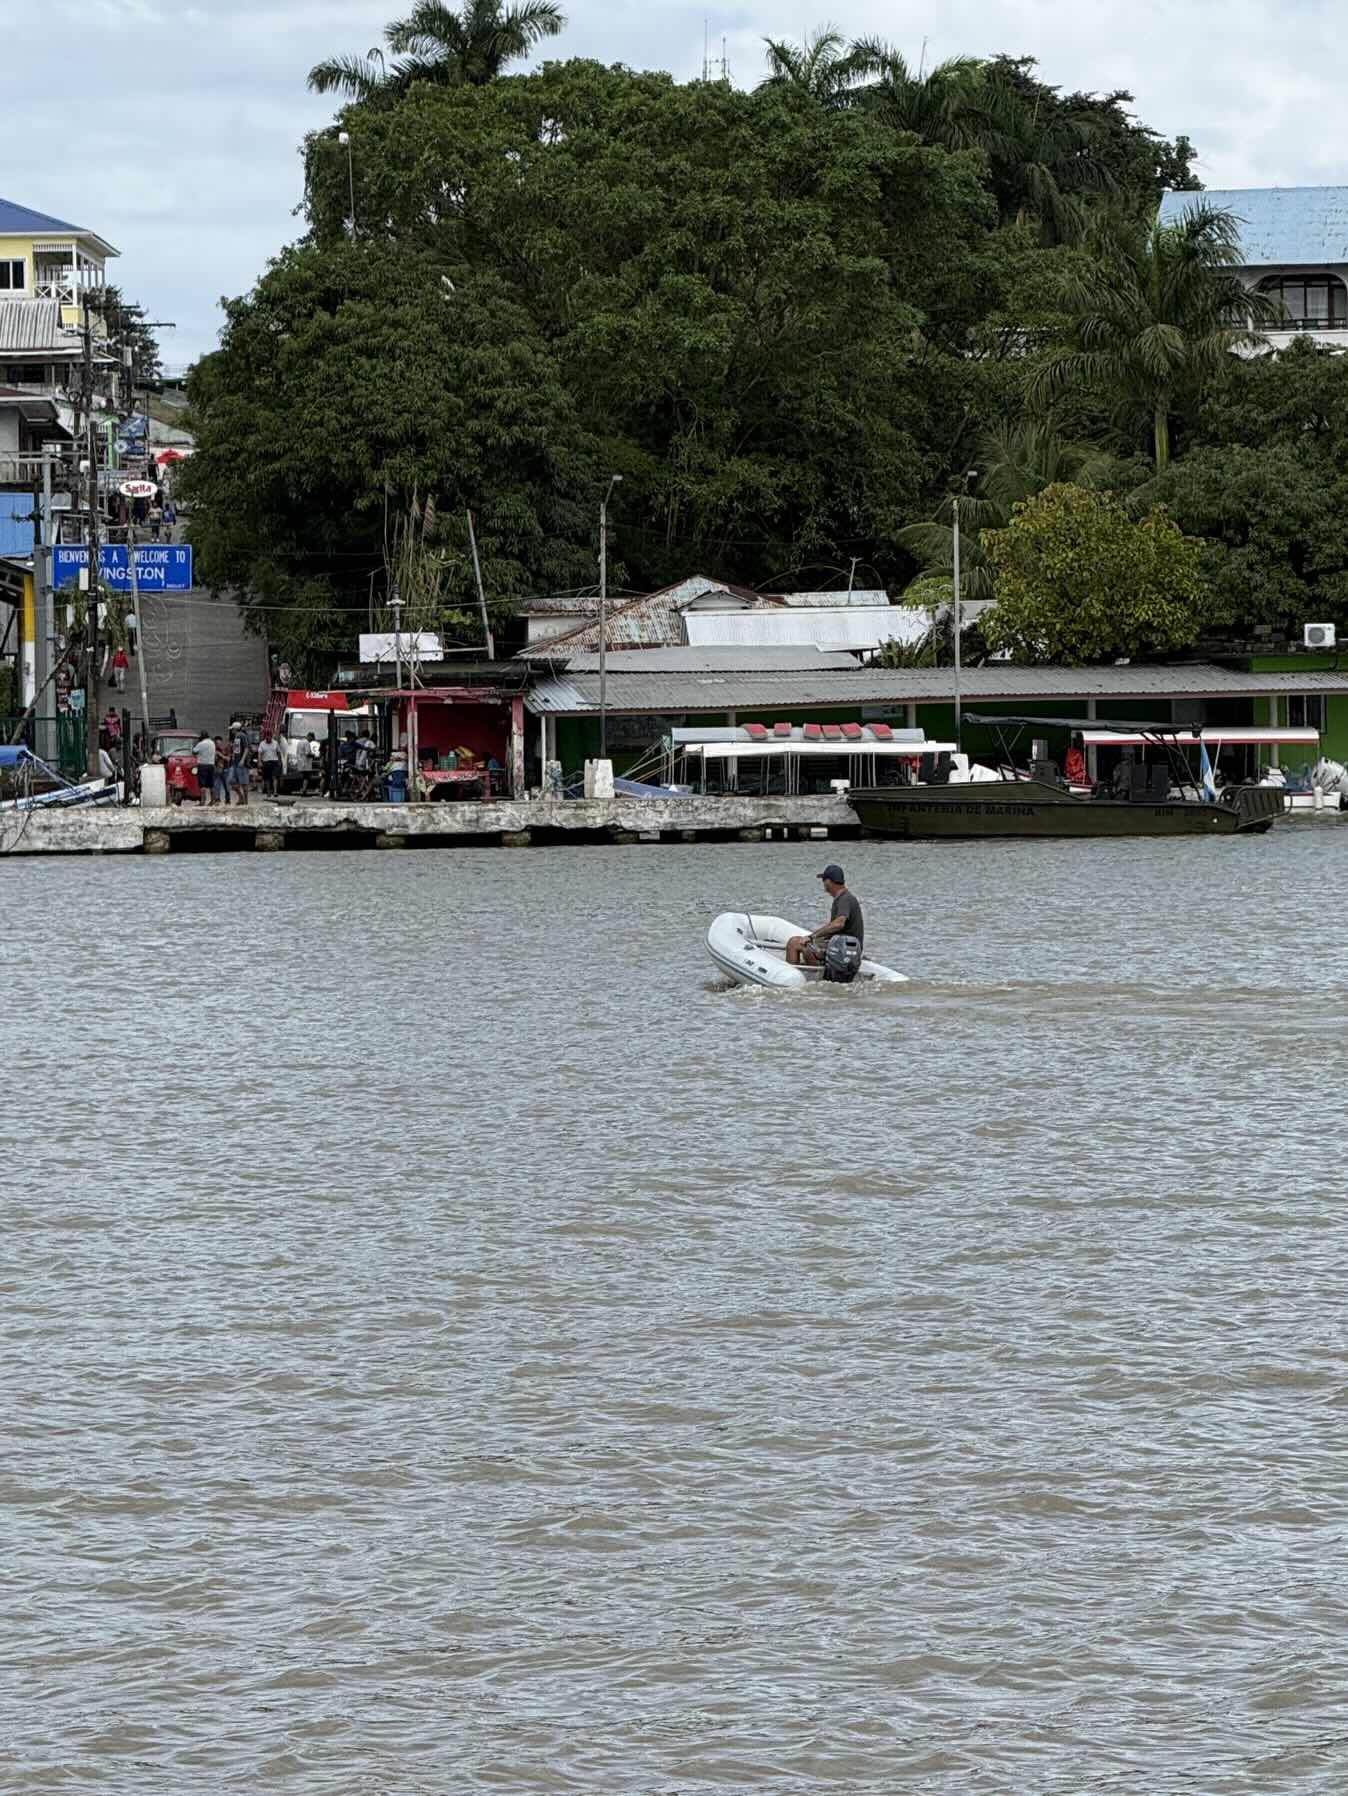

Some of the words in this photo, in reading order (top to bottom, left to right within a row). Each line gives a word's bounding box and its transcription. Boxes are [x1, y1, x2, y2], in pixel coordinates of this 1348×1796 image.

[112, 551, 118, 564] A
[134, 550, 168, 564] WELCOME
[175, 550, 186, 564] TO
[985, 804, 1035, 816] MARINA
